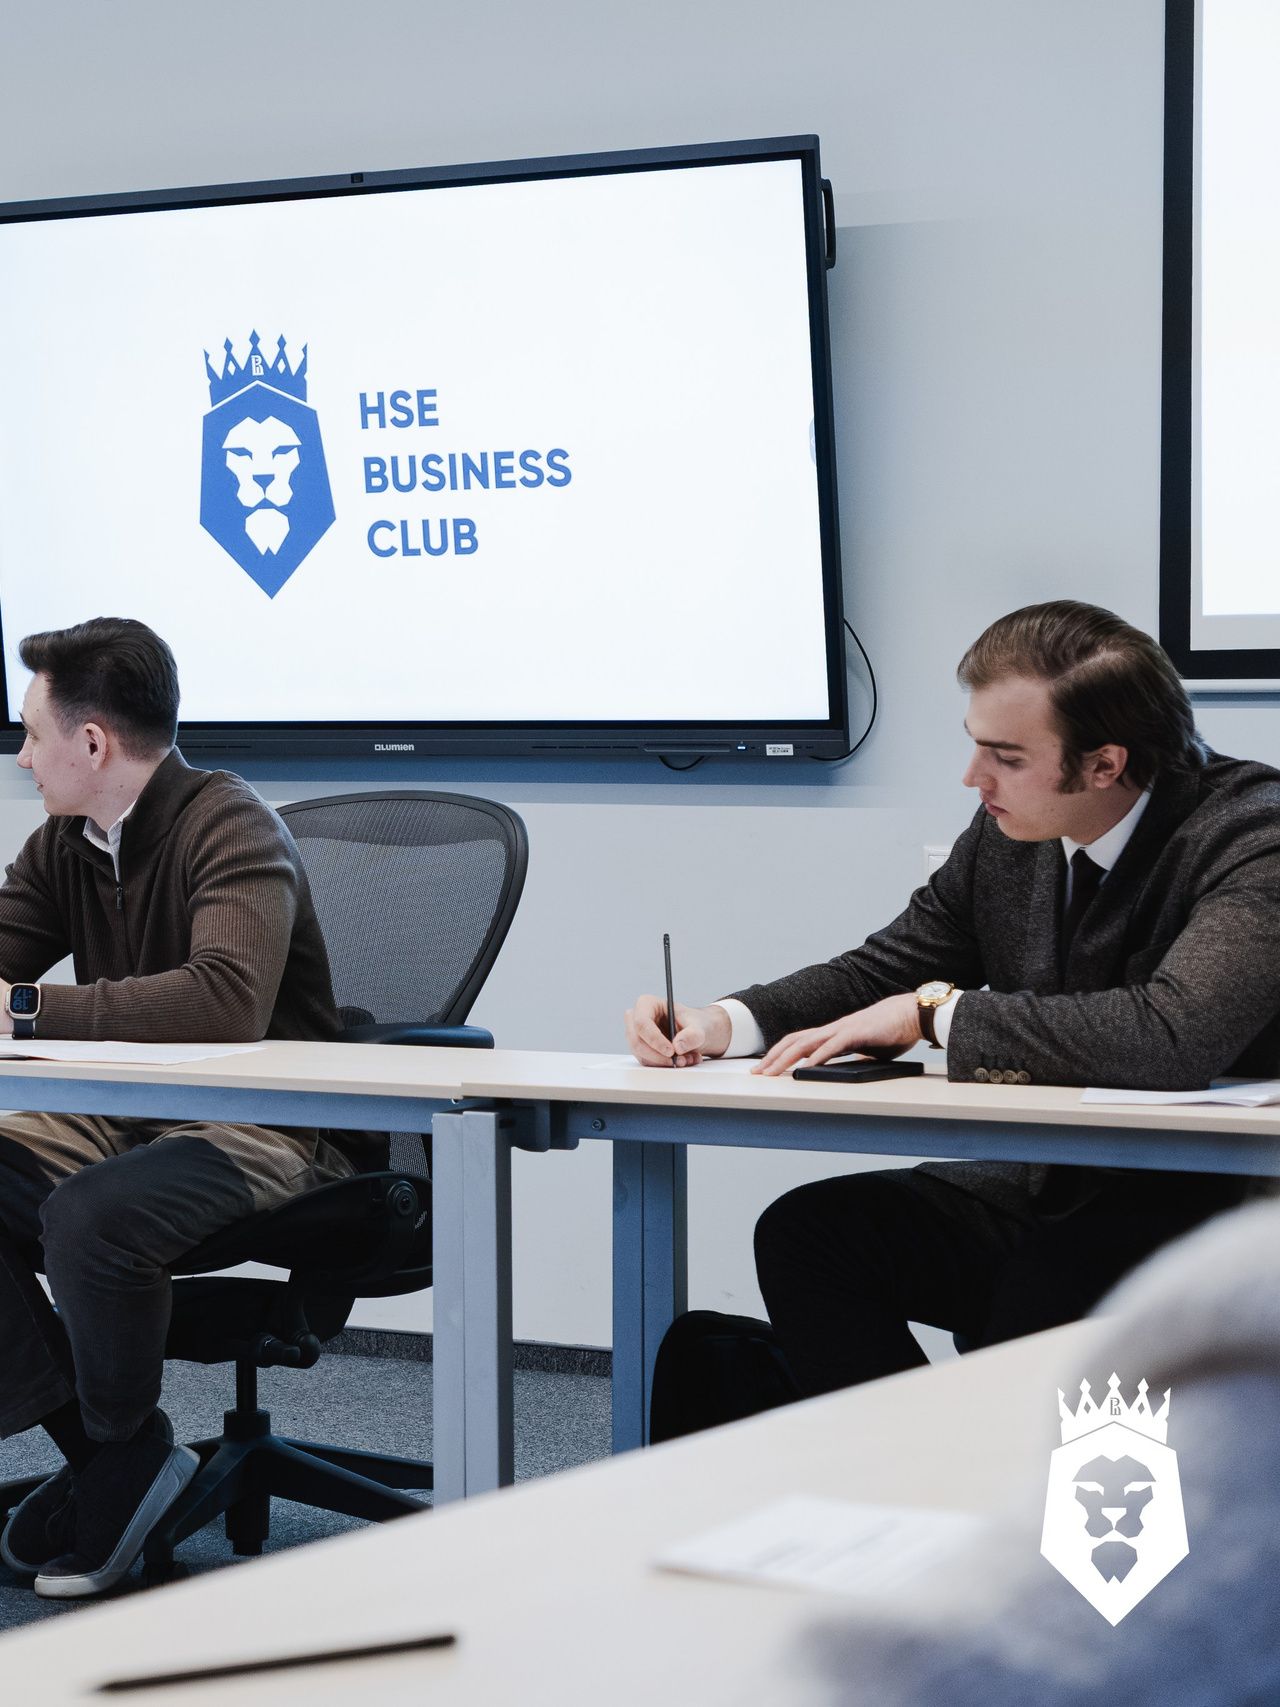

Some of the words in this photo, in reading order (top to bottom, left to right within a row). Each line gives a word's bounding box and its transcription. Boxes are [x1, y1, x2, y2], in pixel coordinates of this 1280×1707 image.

[359, 388, 440, 430] HSE
[363, 448, 573, 494] BUSINESS
[367, 517, 480, 558] CLUB
